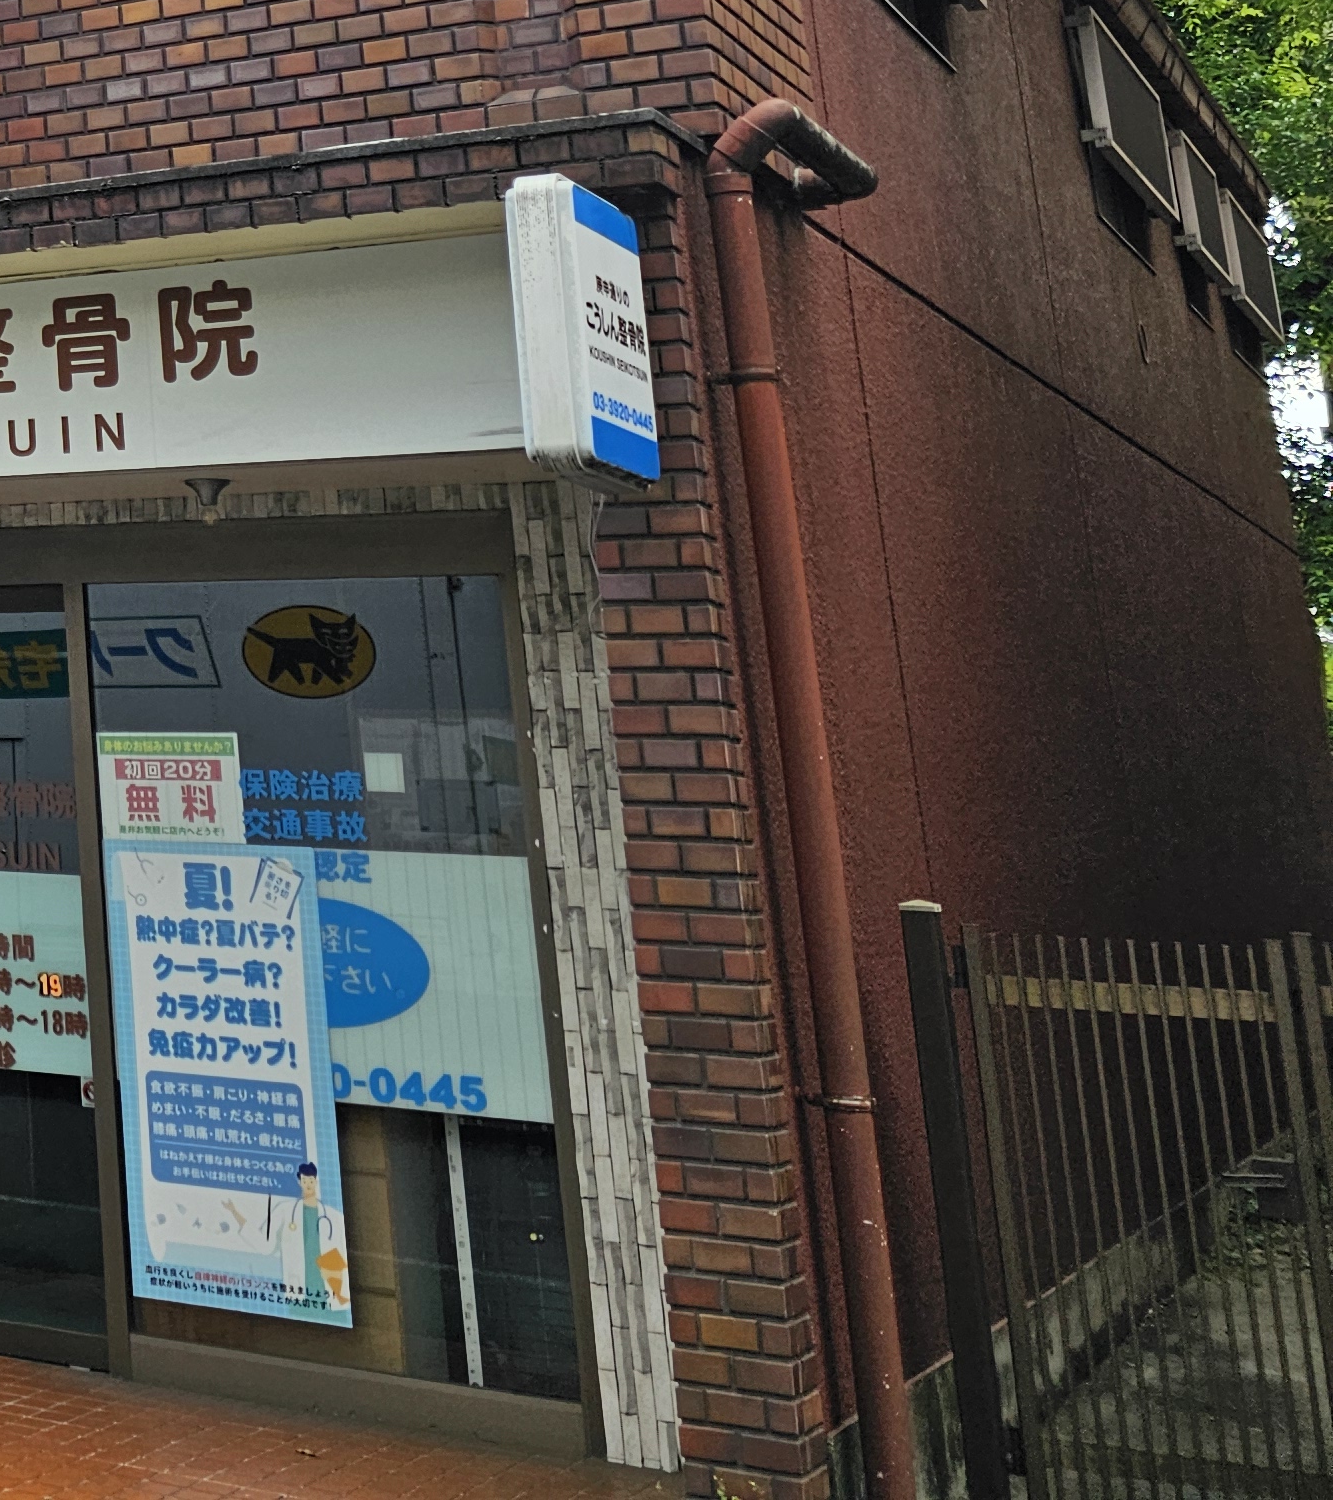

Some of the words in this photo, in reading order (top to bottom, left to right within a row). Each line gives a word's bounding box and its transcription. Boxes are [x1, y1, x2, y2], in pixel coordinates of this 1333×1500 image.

[593, 391, 654, 433] 03-3920-0445
[124, 760, 212, 780] 初回20分
[239, 768, 364, 802] 保険治療
[242, 808, 369, 842] 交通事故
[182, 861, 234, 912] 夏!
[135, 914, 296, 952] 熱中症?夏バテ?
[152, 953, 283, 990] クーラー病?
[156, 991, 283, 1029] カラダ改善!
[147, 1028, 298, 1070] 免疫力アップ!
